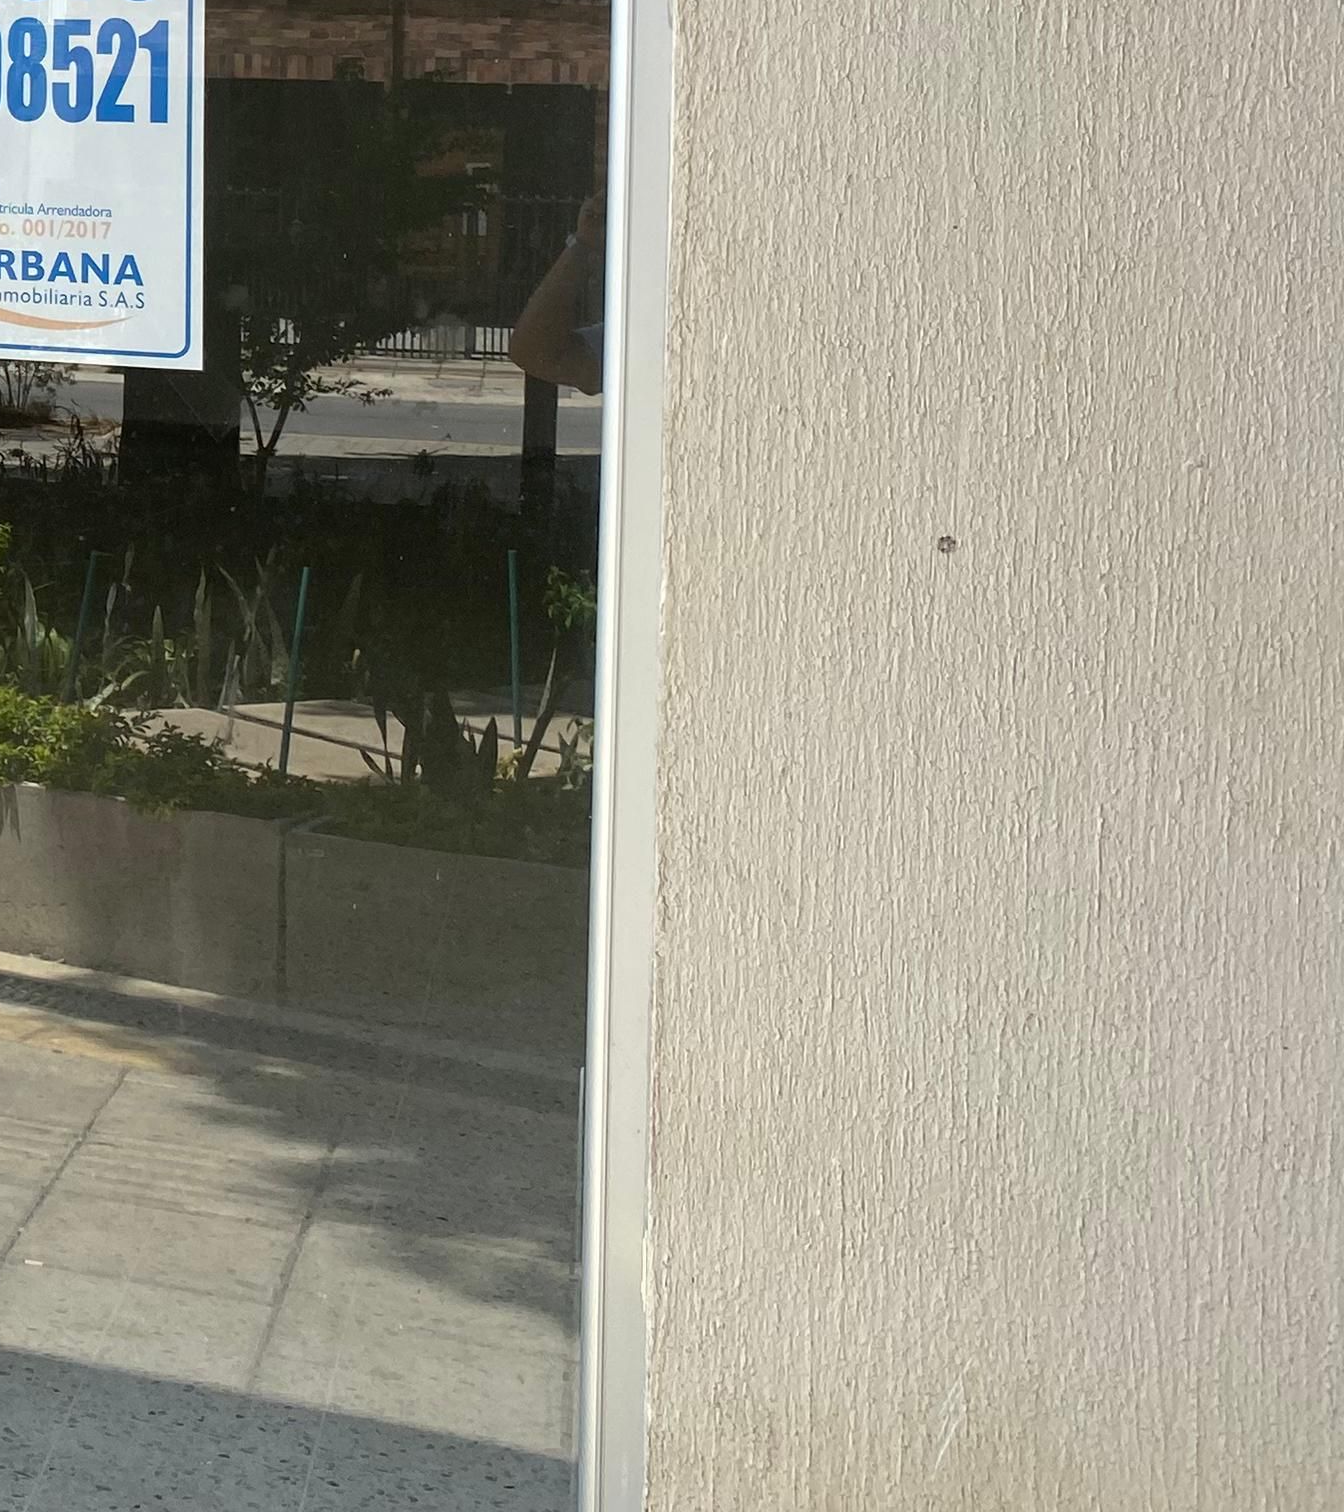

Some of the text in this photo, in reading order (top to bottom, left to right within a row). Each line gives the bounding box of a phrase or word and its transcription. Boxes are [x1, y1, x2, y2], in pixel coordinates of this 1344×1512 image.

[37, 203, 113, 218] Arrendadora
[22, 218, 112, 240] 001/2017
[98, 290, 145, 309] S.A.S
